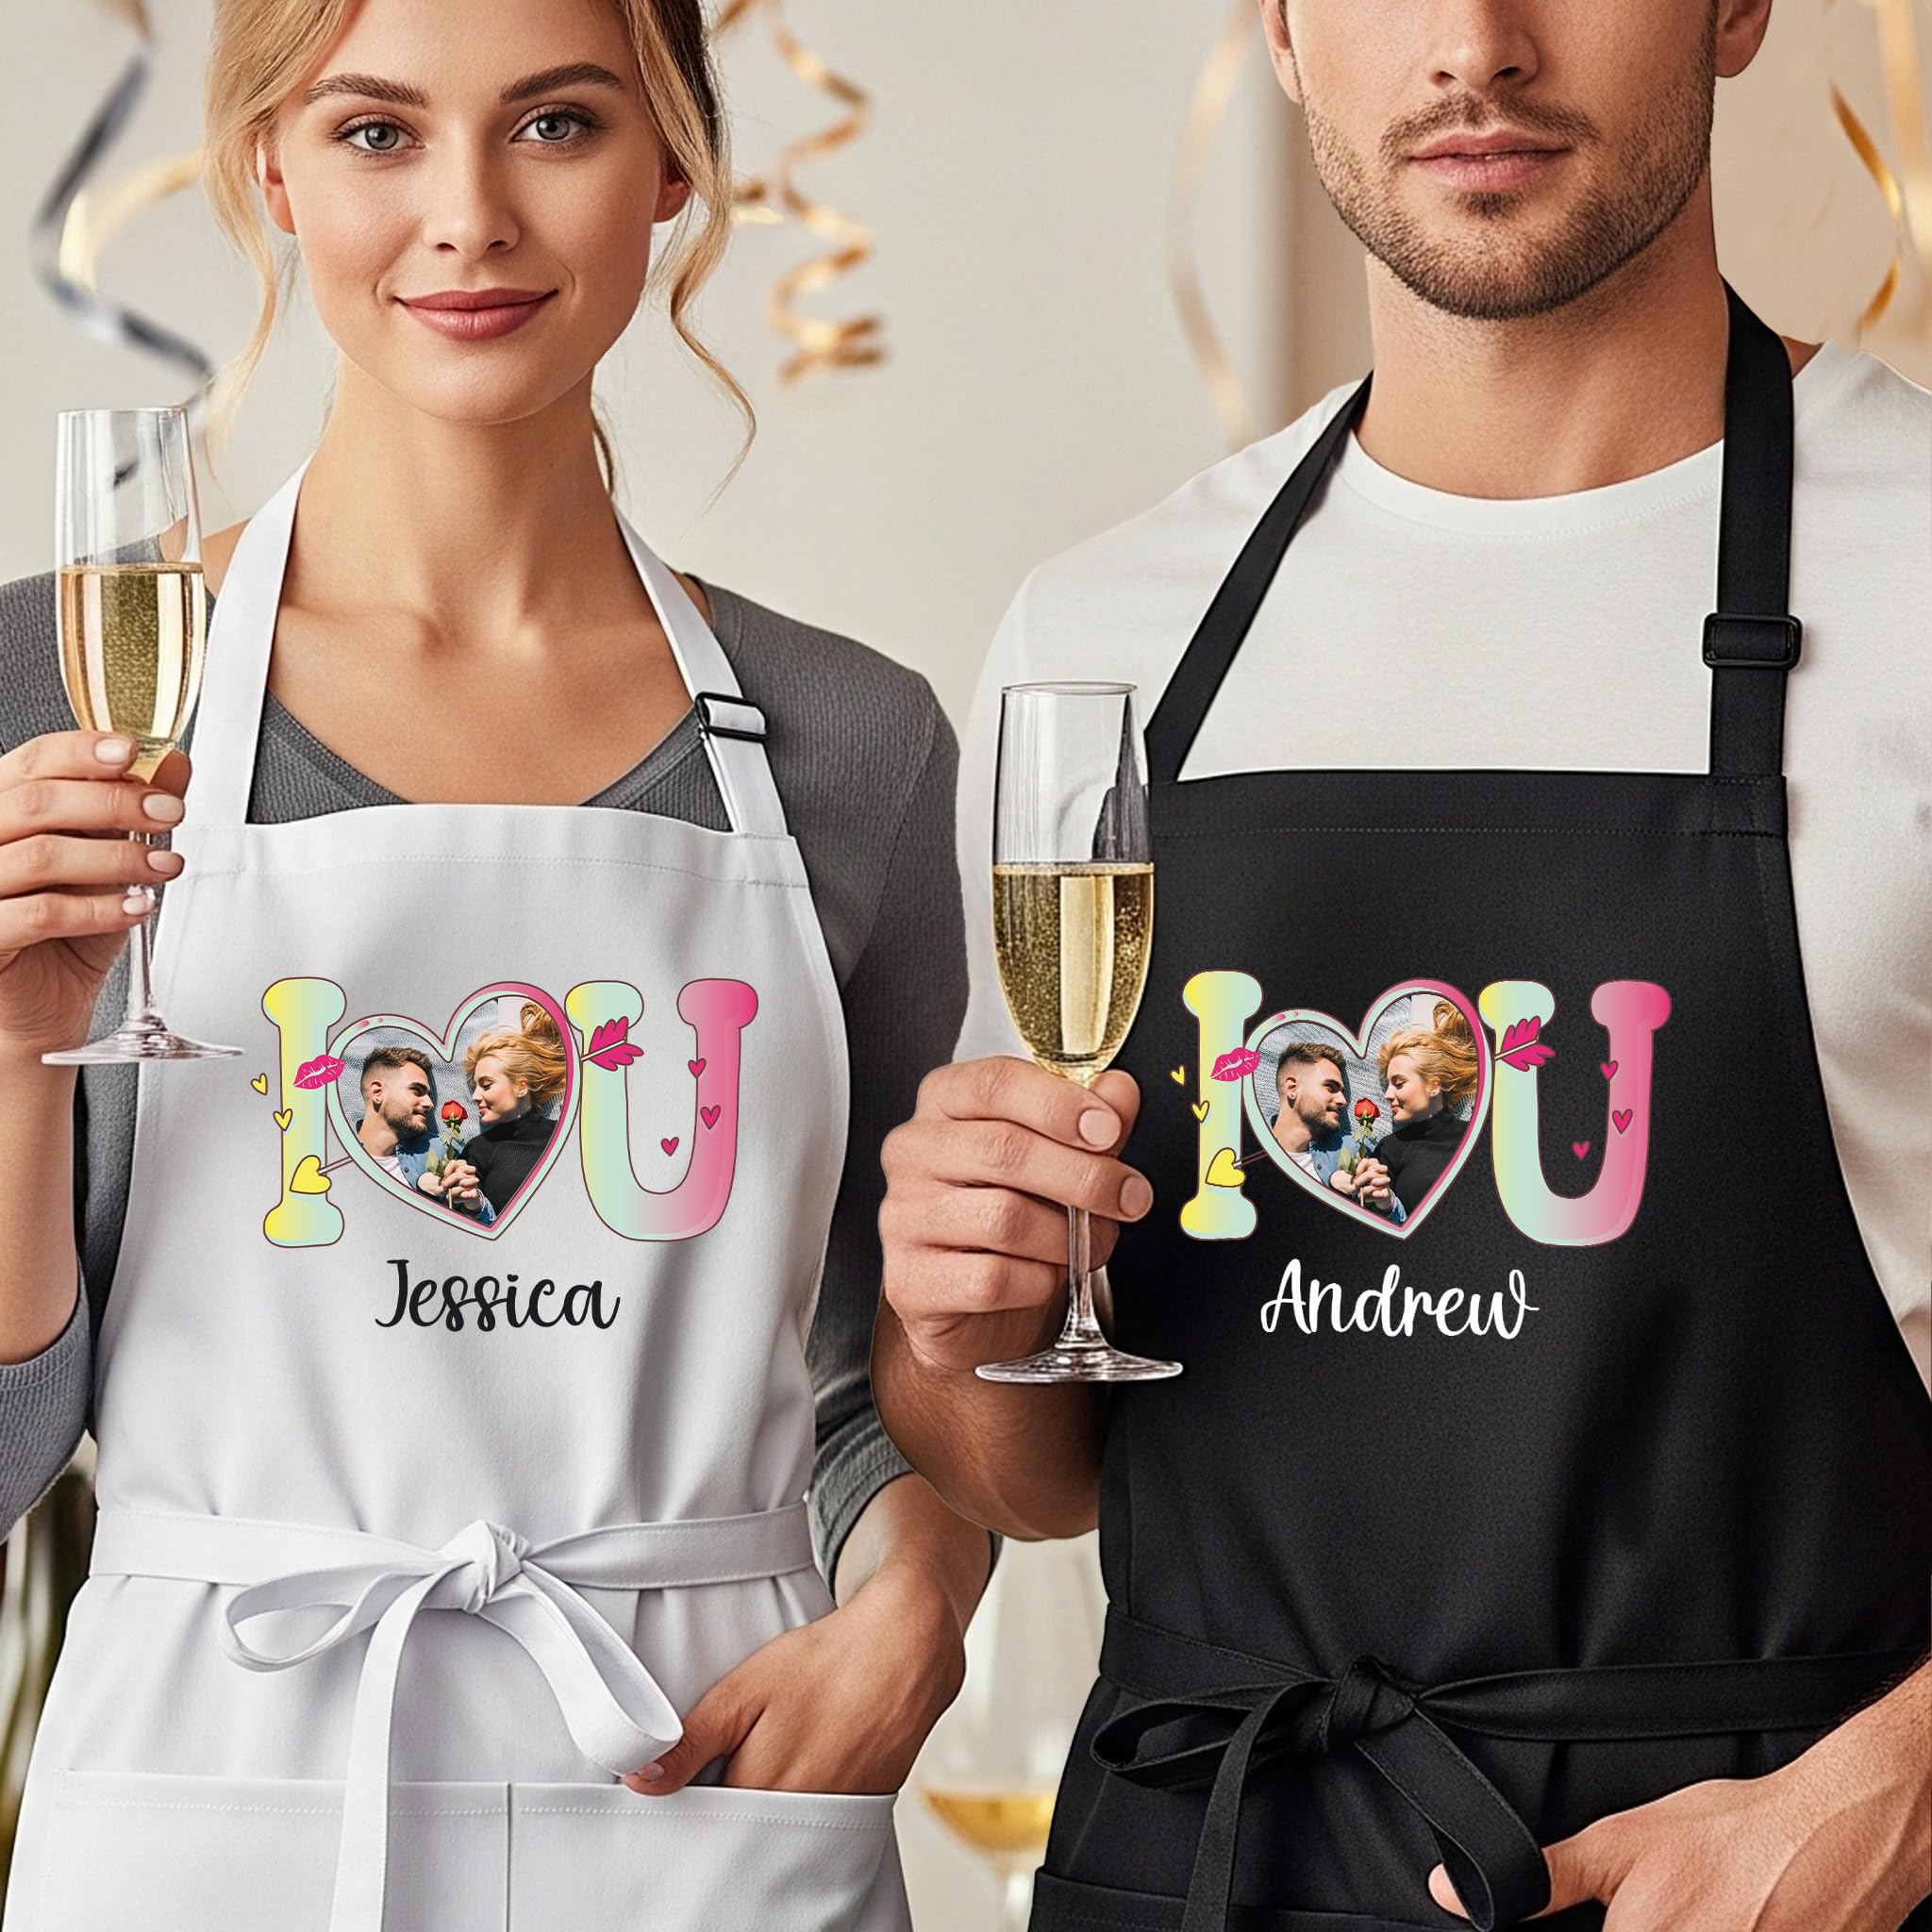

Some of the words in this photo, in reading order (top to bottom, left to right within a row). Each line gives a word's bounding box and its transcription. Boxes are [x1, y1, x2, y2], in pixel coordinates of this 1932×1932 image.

[261, 976, 347, 1247] I
[564, 978, 758, 1242] U
[1179, 970, 1264, 1241] I
[1478, 979, 1673, 1247] U
[375, 1259, 620, 1331] Jessica
[1261, 1258, 1540, 1340] Andrew
